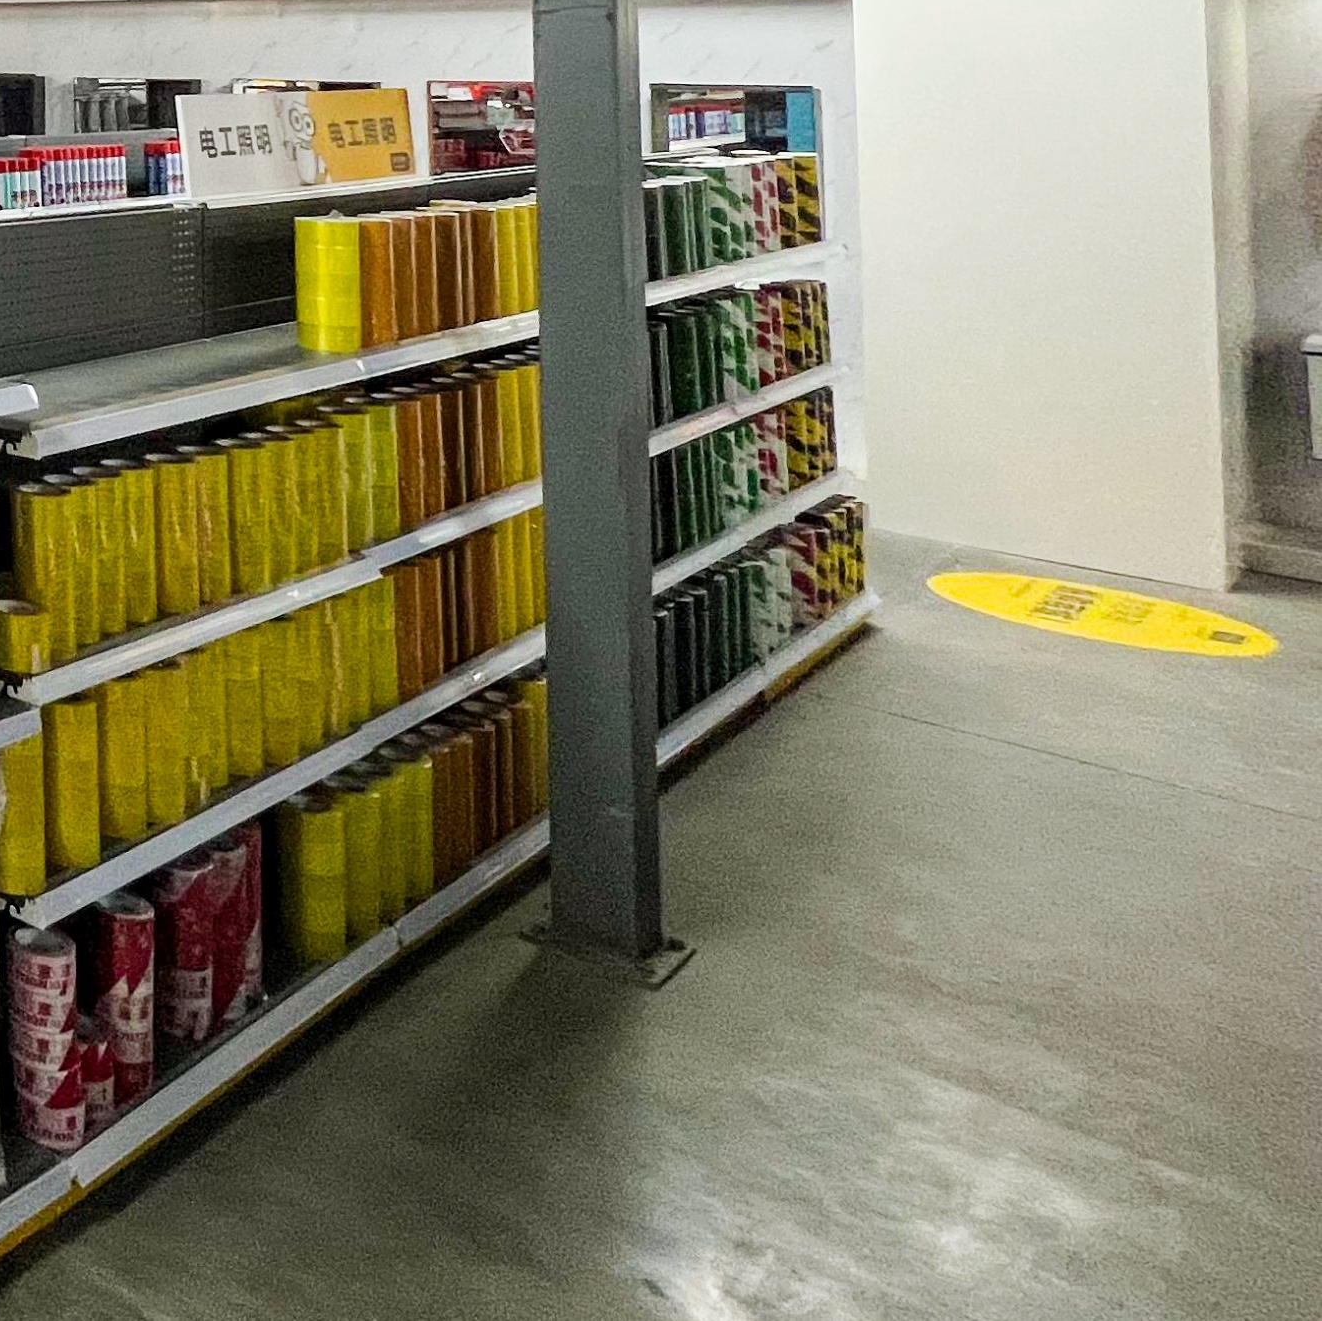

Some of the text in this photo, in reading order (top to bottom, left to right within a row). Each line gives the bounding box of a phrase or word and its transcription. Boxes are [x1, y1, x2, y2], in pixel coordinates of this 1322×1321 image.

[199, 123, 272, 159] 电工照明
[327, 116, 396, 148] 电工照明
